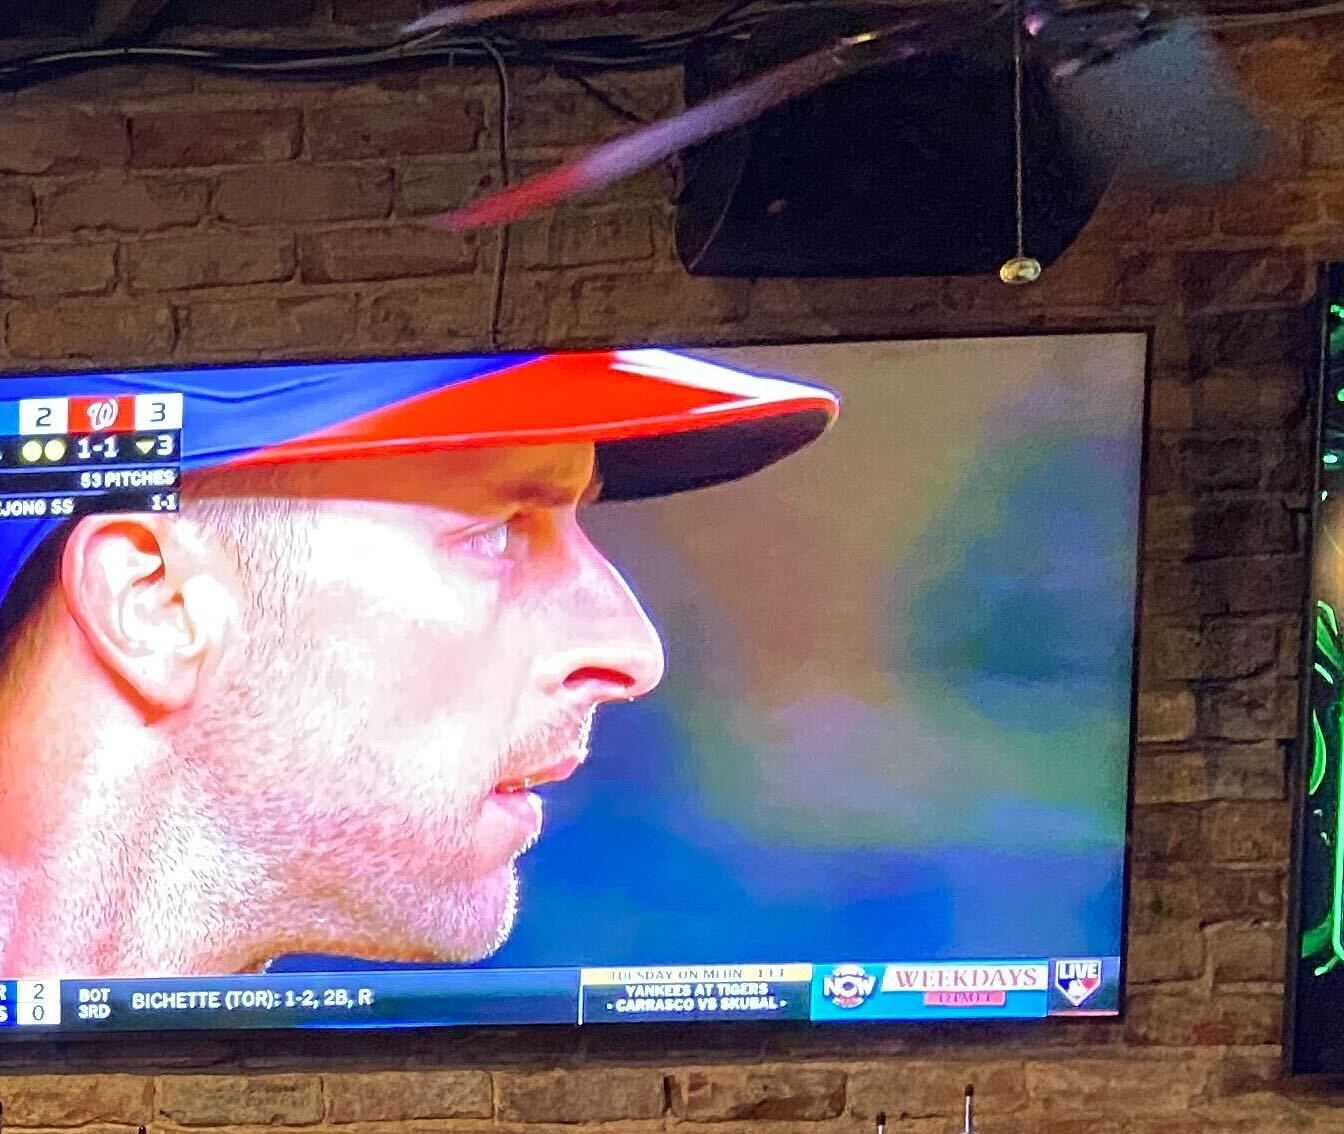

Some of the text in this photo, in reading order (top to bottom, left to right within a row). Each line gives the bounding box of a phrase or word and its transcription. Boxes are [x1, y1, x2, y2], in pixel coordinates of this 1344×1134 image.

[35, 407, 52, 427] 2
[150, 402, 167, 422] 3
[77, 435, 173, 459] 1-1 3
[104, 470, 176, 487] PITCHES
[50, 498, 75, 515] SS
[151, 494, 178, 510] 1-1
[894, 966, 1039, 988] WEEKDAYS
[1057, 962, 1100, 981] LIVE
[33, 983, 44, 999] 2
[79, 988, 110, 1003] BOT
[624, 983, 769, 997] YANKEES AT TIGERS
[822, 976, 876, 997] NOW
[131, 991, 221, 1010] BICHETTE
[224, 989, 281, 1010] (TOR):
[284, 989, 319, 1010] 1-2,
[358, 989, 373, 1006] R
[32, 1005, 45, 1021] 0
[78, 1003, 110, 1019] 3RD
